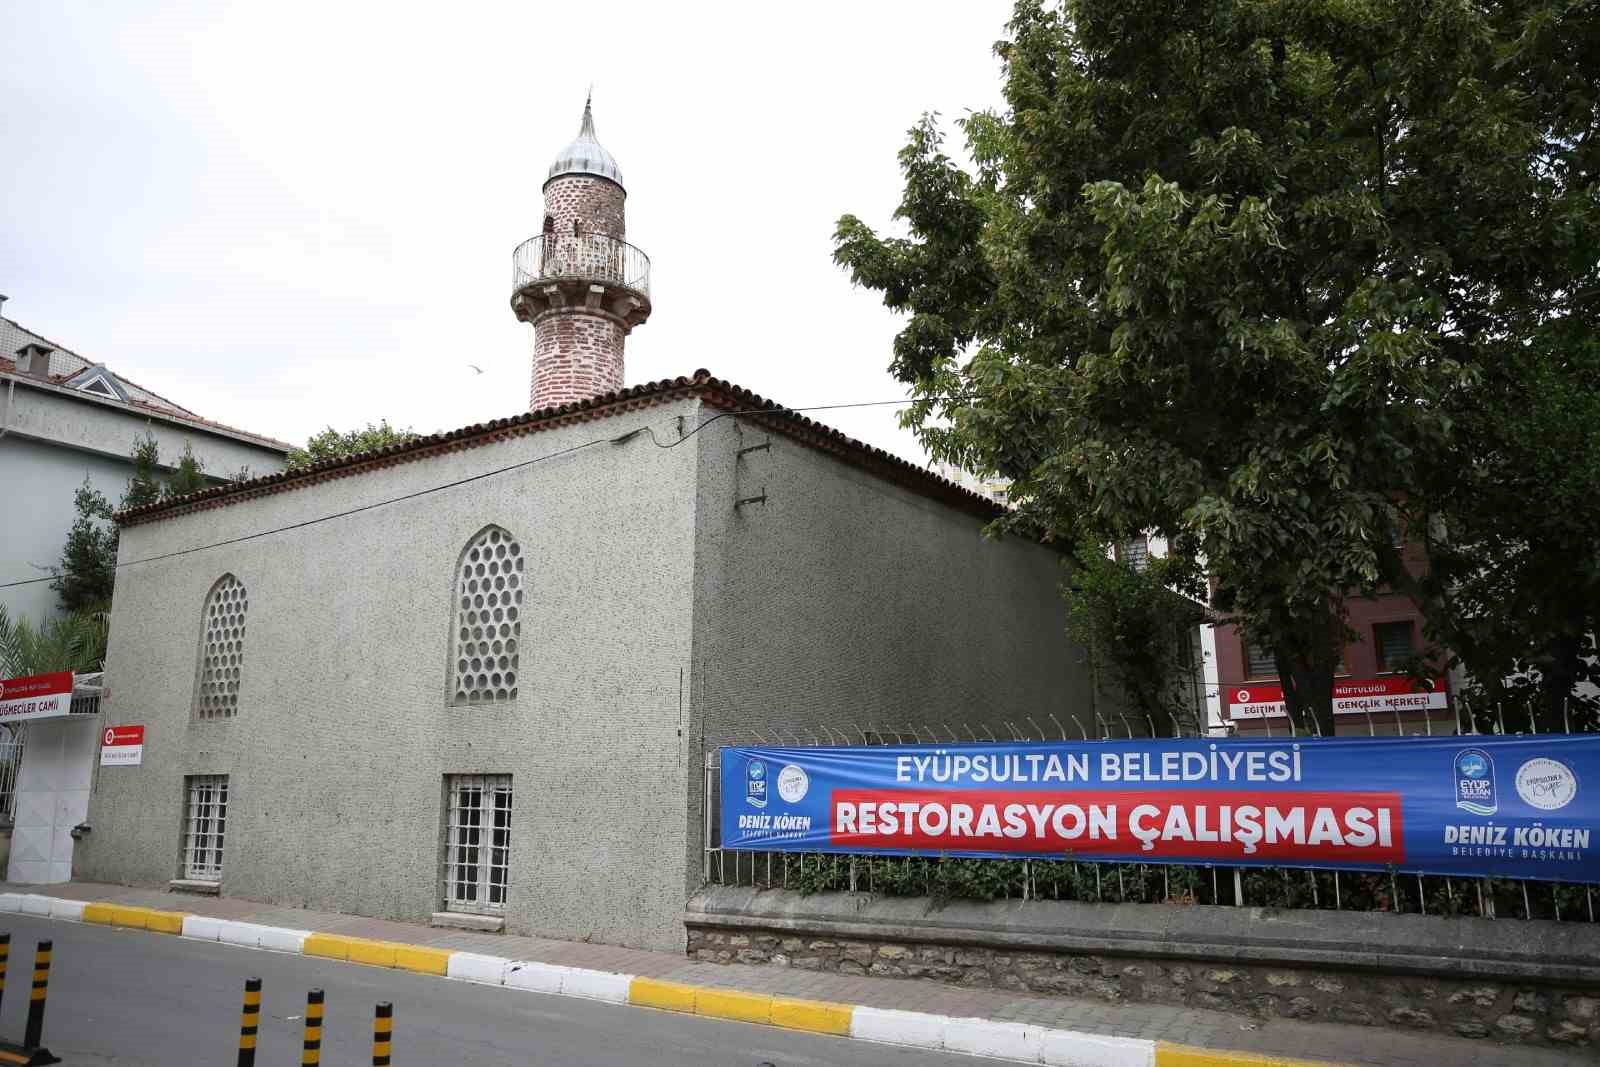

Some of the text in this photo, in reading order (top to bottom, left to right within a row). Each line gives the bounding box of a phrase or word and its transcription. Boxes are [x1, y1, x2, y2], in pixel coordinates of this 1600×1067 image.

[1337, 699, 1381, 710] GENÇLİK
[1385, 694, 1430, 706] MERKEZİ
[896, 743, 1302, 783] EYÜPSULTAN BELEDİYESİ
[739, 811, 811, 830] DENİZ KÖKEN
[836, 802, 1393, 854] RESTORASYON ÇALIŞMASI
[1444, 821, 1590, 849] DENİZ KÖKEN
[1452, 846, 1582, 862] BELEDİYE BAŞKANI
